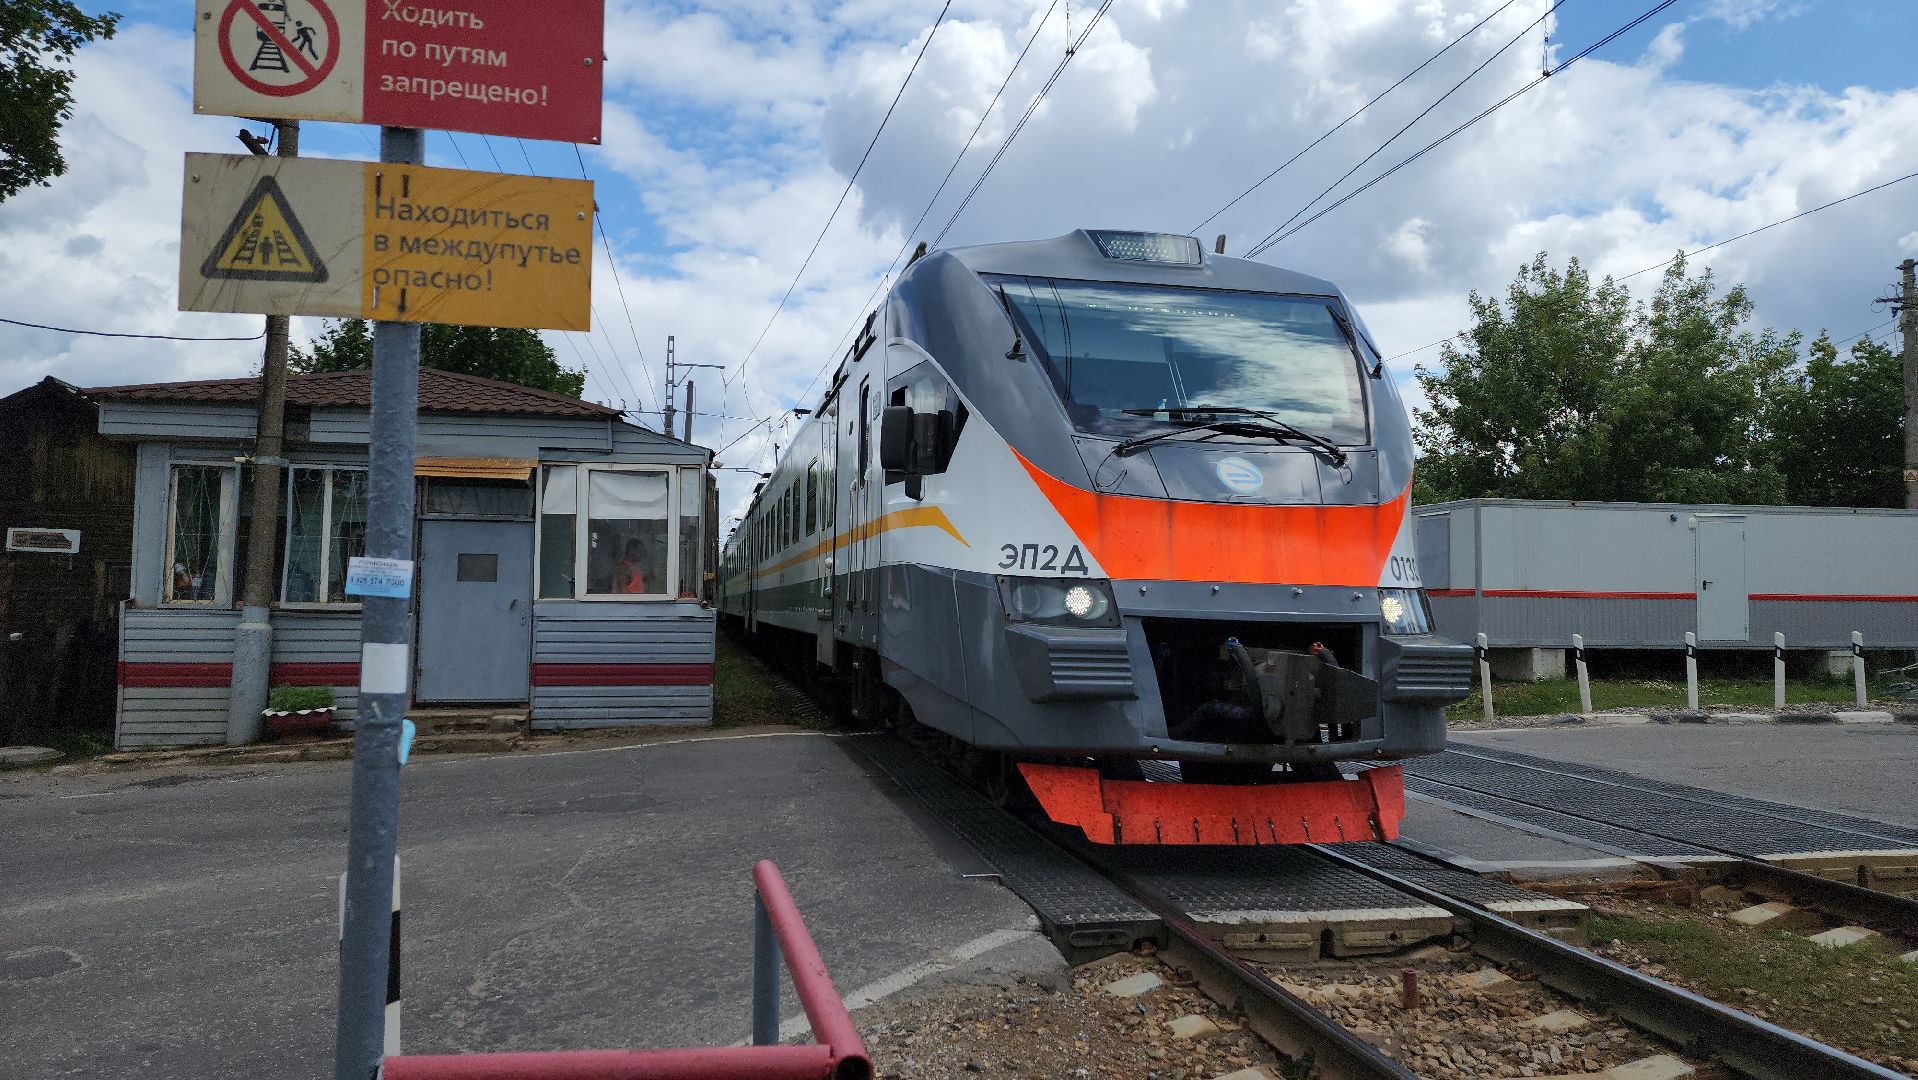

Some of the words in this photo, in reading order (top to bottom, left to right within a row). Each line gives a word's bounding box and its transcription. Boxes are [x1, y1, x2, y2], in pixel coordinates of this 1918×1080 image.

[381, 0, 485, 30] Ходить
[382, 39, 417, 58] по
[425, 43, 508, 67] путям
[380, 74, 548, 106] запрещено!
[375, 196, 550, 231] Находиться
[373, 234, 389, 251] в
[400, 235, 581, 268] междупутье
[373, 268, 493, 292] опасно!
[998, 543, 1089, 576] ЭП2Д
